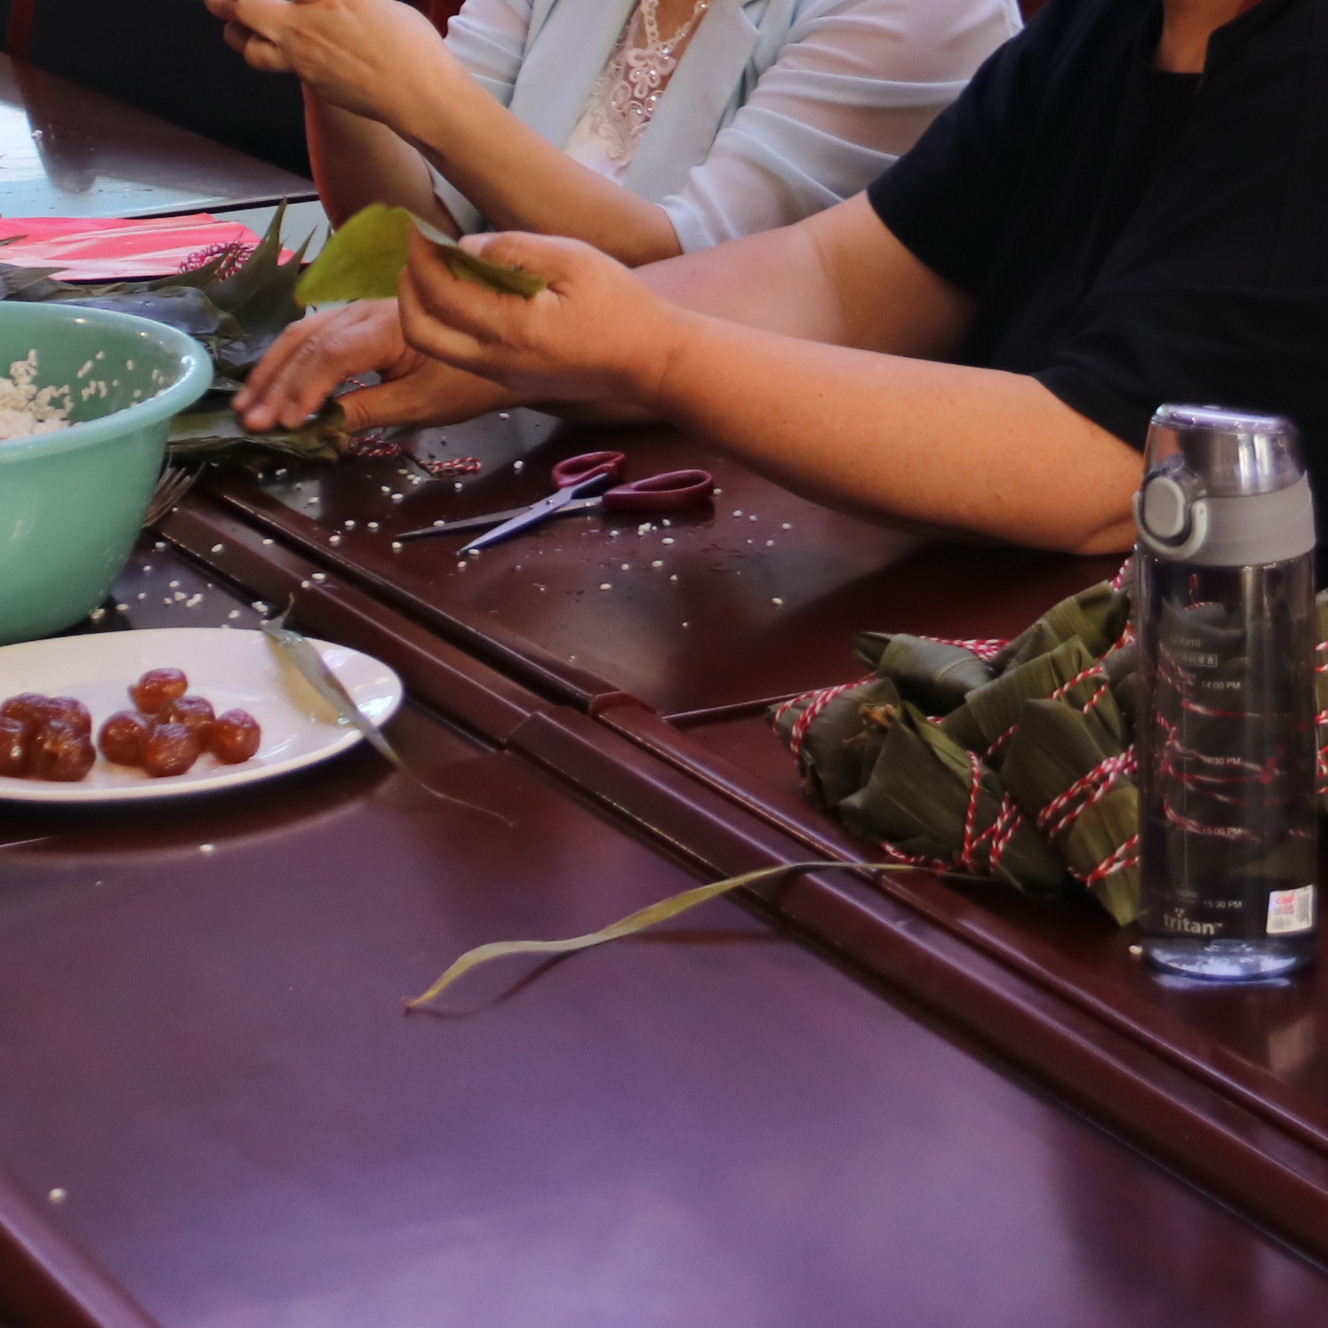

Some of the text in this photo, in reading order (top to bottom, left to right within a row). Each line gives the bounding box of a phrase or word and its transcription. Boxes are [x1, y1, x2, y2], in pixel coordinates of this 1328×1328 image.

[1226, 681, 1241, 690] PM
[1226, 757, 1241, 765] PM
[1228, 900, 1242, 908] PM
